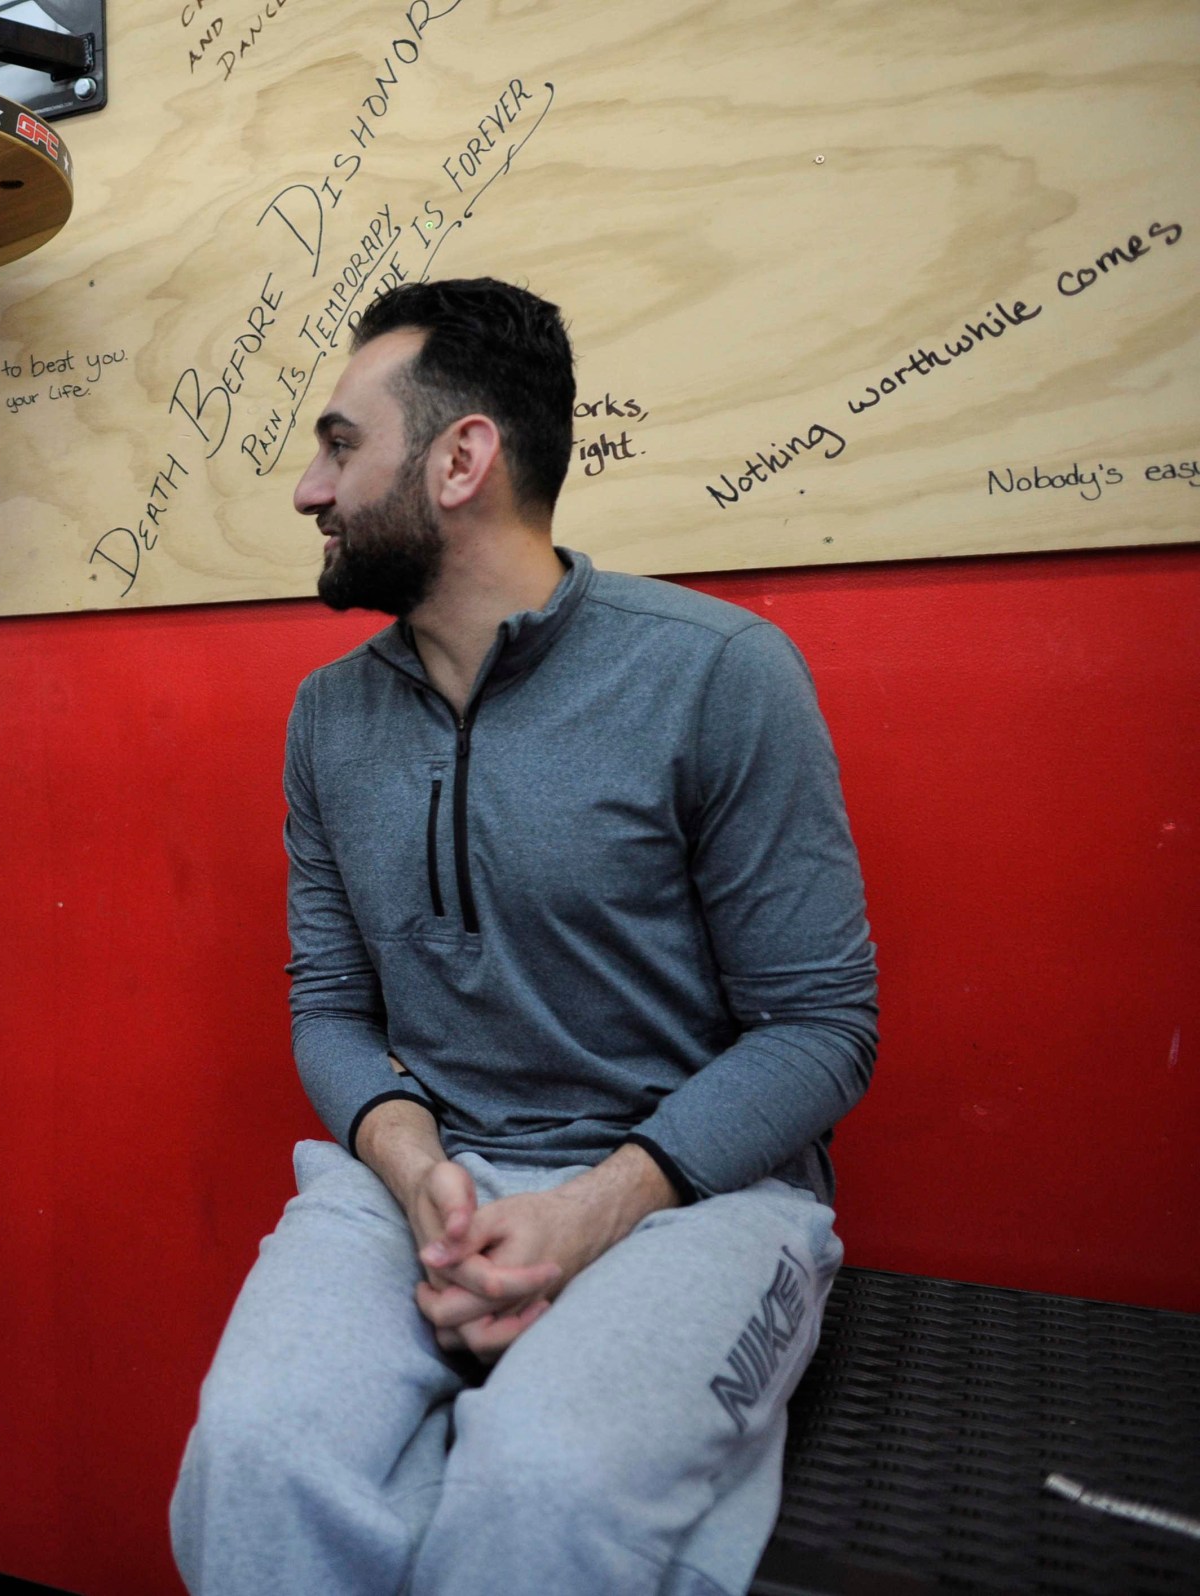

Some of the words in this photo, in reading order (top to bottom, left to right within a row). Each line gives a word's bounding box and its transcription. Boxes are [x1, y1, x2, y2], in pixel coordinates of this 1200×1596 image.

[189, 17, 223, 74] AND
[16, 112, 59, 160] GFC
[442, 78, 533, 193] FOREVER
[89, 452, 189, 598] DEATH
[168, 273, 284, 459] BEFORE
[256, 0, 462, 277] DISHONOR
[1, 360, 22, 378] to
[31, 350, 74, 378] beat
[706, 421, 846, 509] Nothing
[847, 299, 1042, 415] worthwhile
[1056, 221, 1183, 297] comes
[6, 393, 39, 414] your
[573, 392, 649, 422] orks,
[241, 408, 282, 466] PAIN
[988, 463, 1125, 501] Nobody's
[709, 1258, 806, 1433] NIKE
